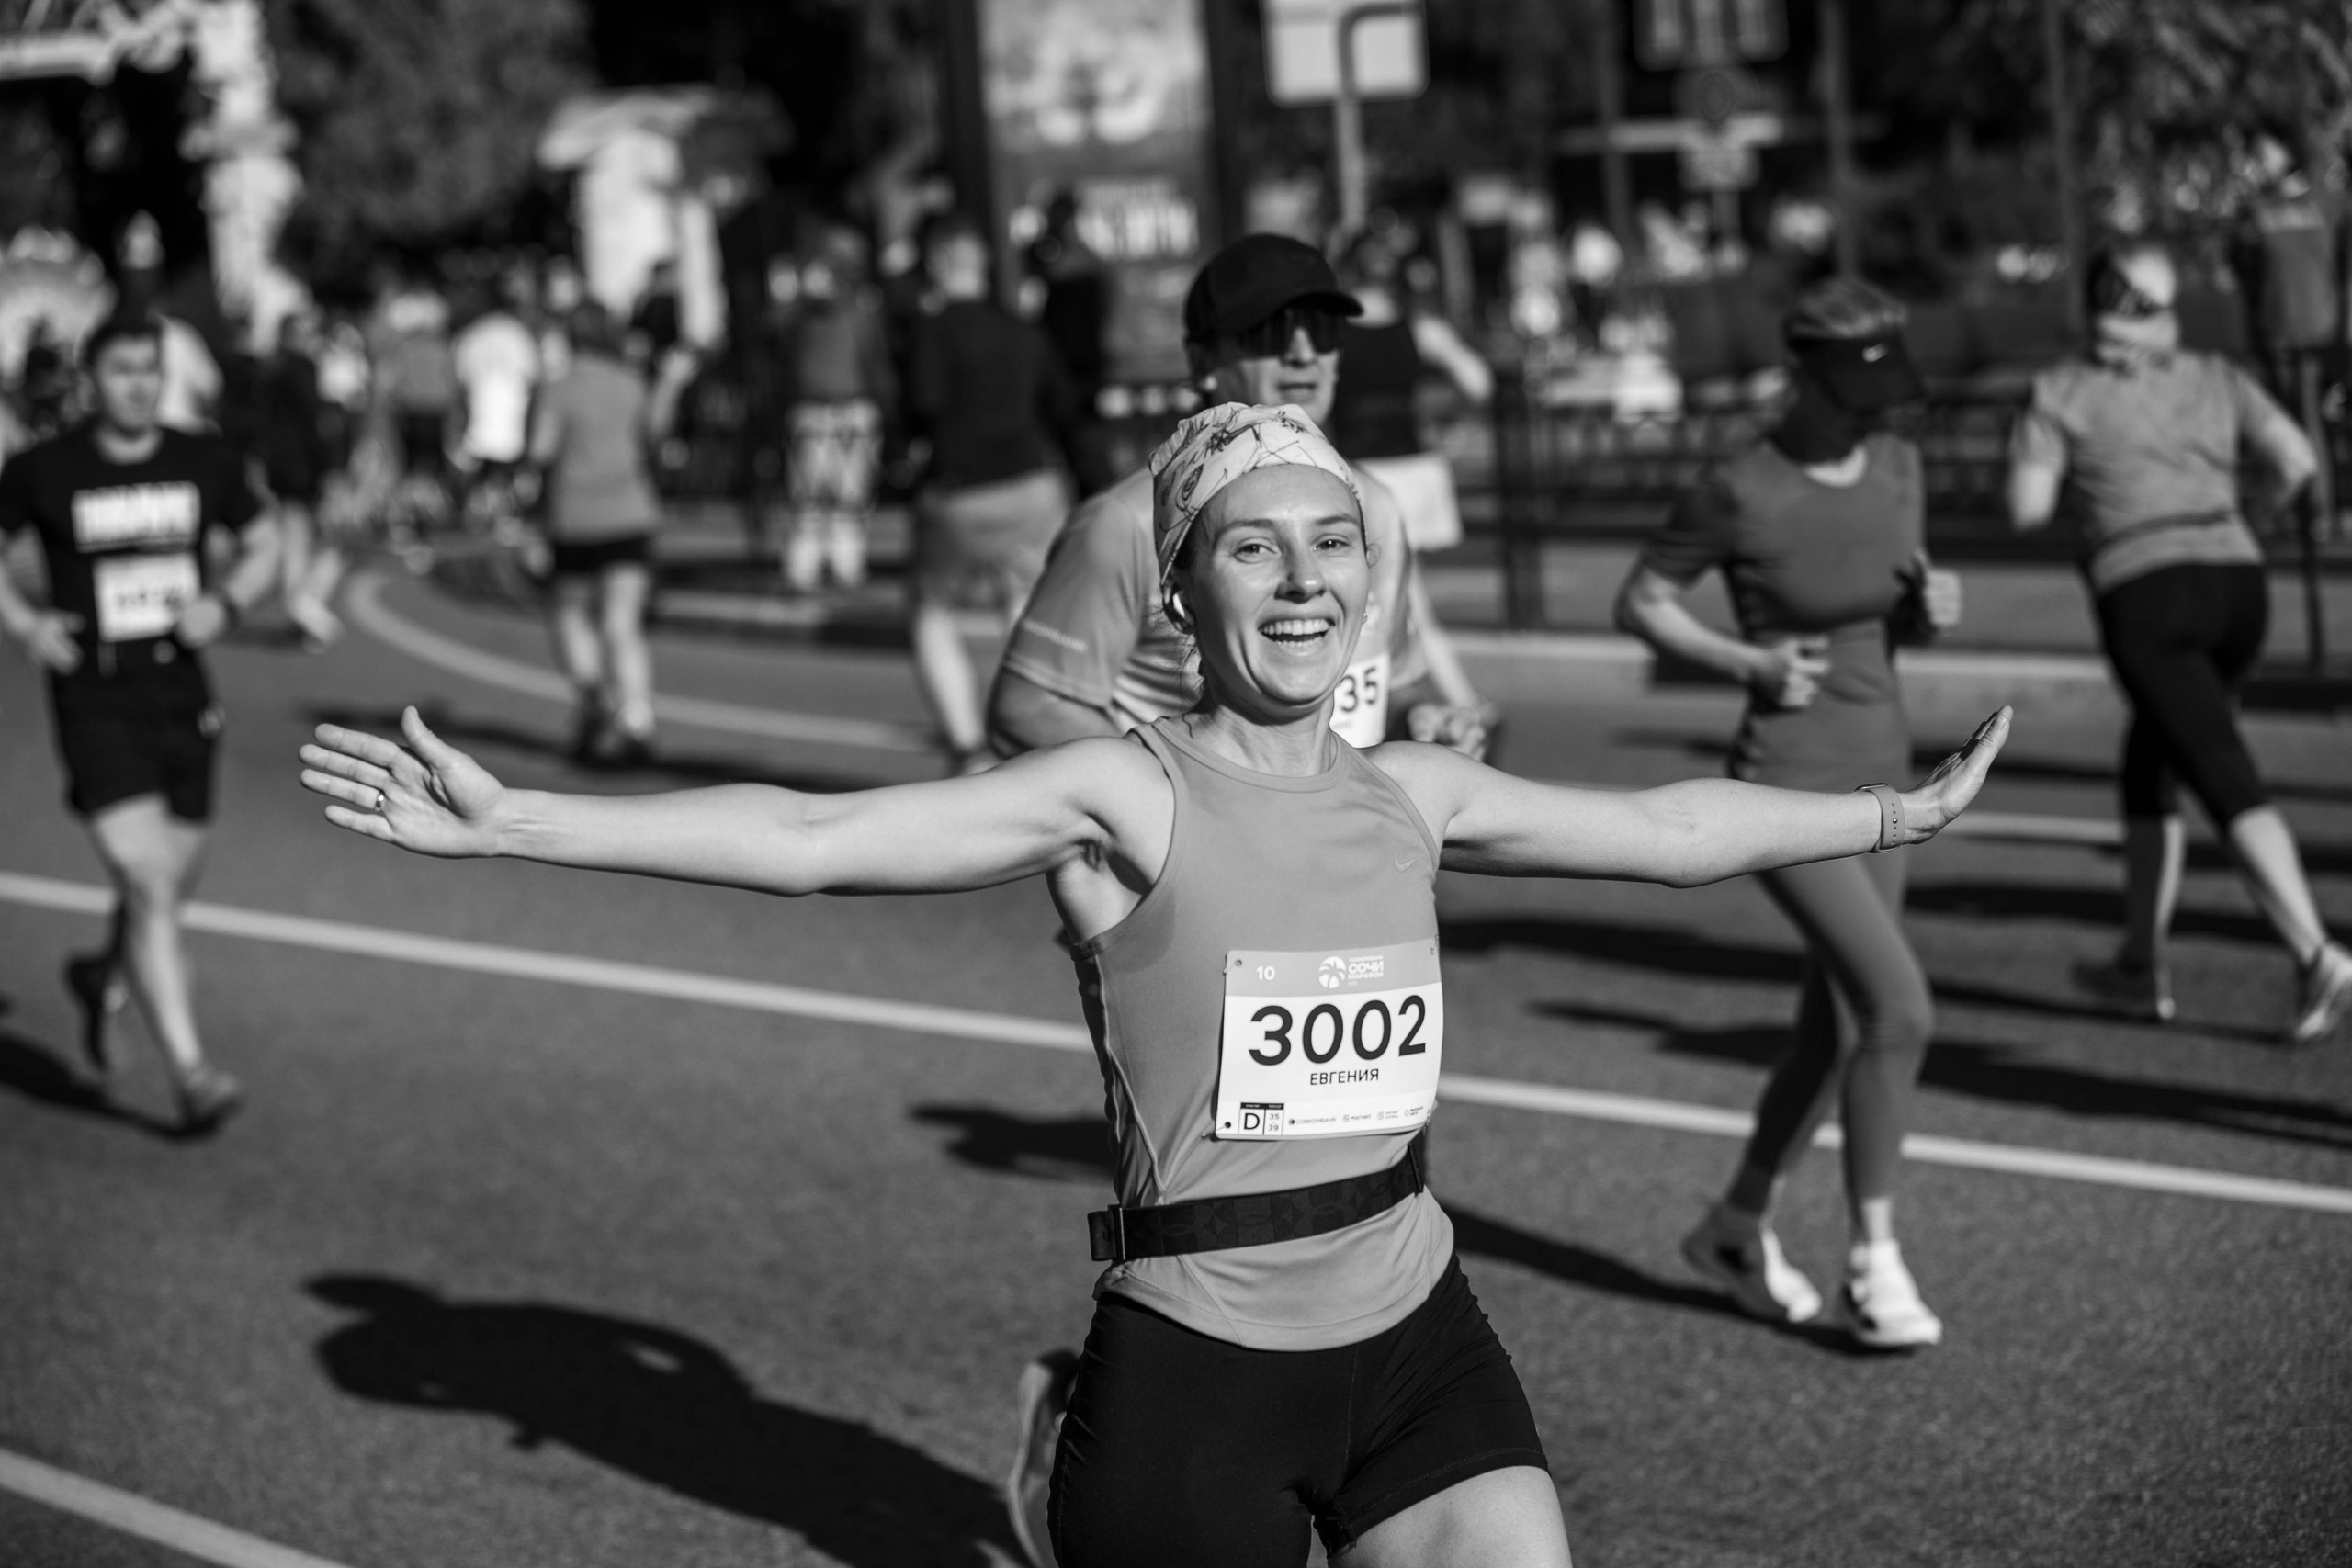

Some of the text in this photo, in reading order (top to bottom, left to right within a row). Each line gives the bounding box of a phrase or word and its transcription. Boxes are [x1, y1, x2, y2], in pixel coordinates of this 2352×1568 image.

[1256, 965, 1276, 981] 10
[1348, 961, 1385, 975] СОЧИ
[1249, 995, 1427, 1066] 3002
[1310, 1068, 1380, 1086] ЕВГЕНИЯ
[1244, 1112, 1261, 1130] D
